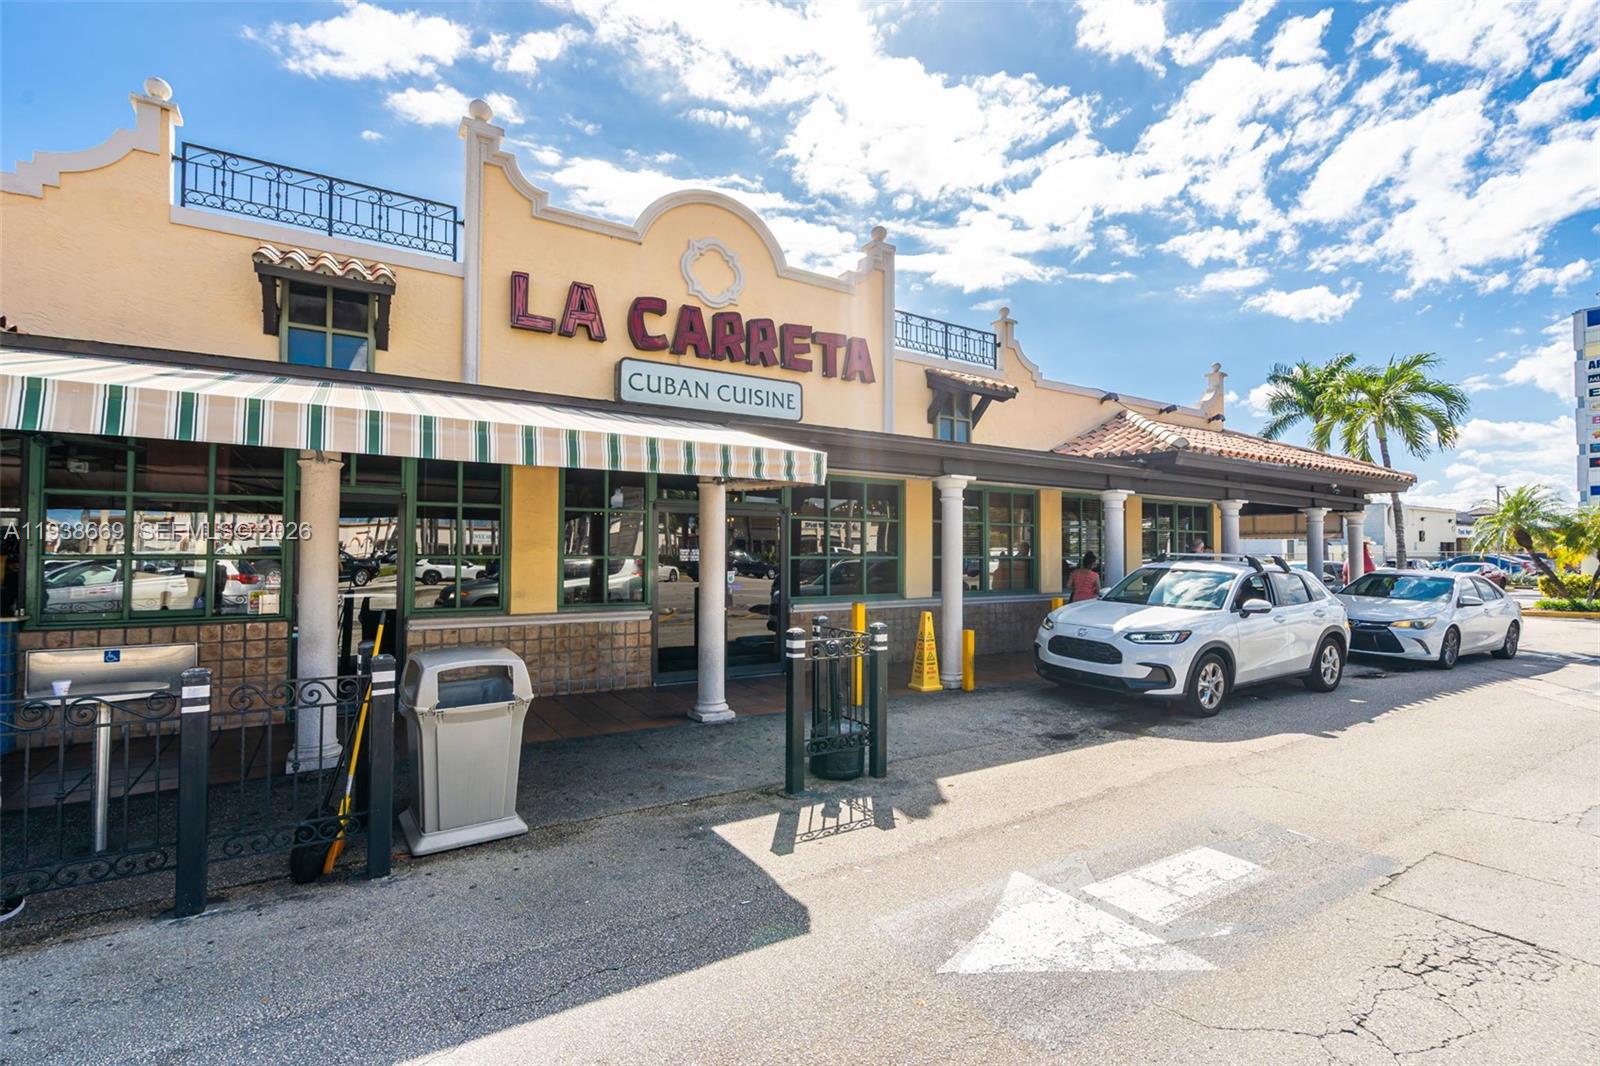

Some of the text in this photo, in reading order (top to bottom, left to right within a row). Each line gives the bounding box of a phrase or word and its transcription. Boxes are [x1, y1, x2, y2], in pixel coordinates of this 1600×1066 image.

[510, 271, 876, 384] LA CARRETA
[627, 372, 797, 410] CUBAN CUISINE
